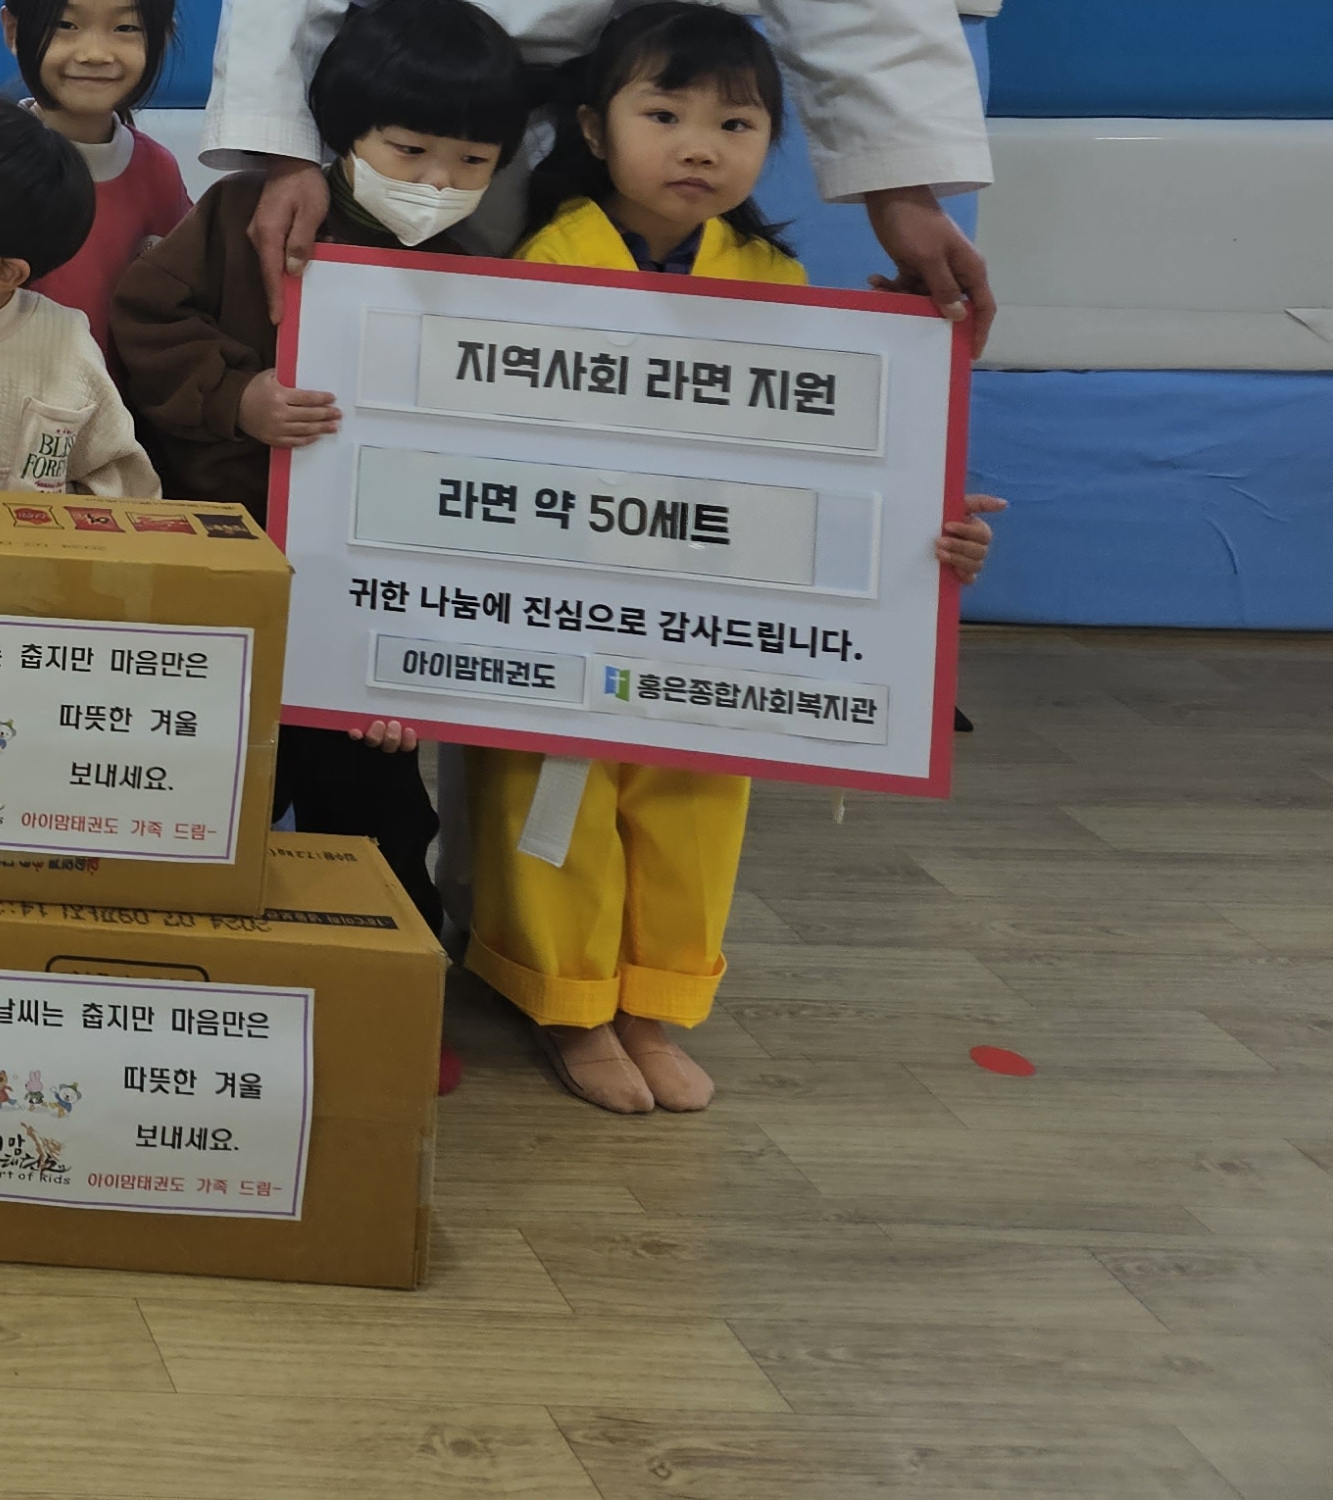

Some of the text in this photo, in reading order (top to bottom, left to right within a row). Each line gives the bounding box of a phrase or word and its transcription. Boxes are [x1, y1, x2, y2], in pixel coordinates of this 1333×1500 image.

[456, 341, 835, 416] 지역사회 라면 지원
[439, 478, 730, 545] 라면 약 50세트
[349, 578, 862, 662] 귀한 나눔에 진심으로 감사드립니다.
[21, 644, 94, 672] 춥지만
[111, 649, 208, 679] 마음만은
[403, 647, 557, 689] 아이맘태권도
[637, 674, 877, 725] 홍은종합사회복지관
[60, 704, 197, 737] 따뜻한 겨울
[69, 762, 173, 790] 보내세요.
[21, 812, 162, 837] 아이맘태권도 가족
[82, 1002, 155, 1032] 춥지만
[172, 1008, 269, 1039] 마음만은
[124, 1066, 262, 1099] 따뜻한 겨울
[136, 1124, 239, 1151] 보내세요.
[17, 1170, 35, 1182] of
[41, 1172, 71, 1185] kids
[88, 1173, 227, 1194] 아이맘태권도 가족
